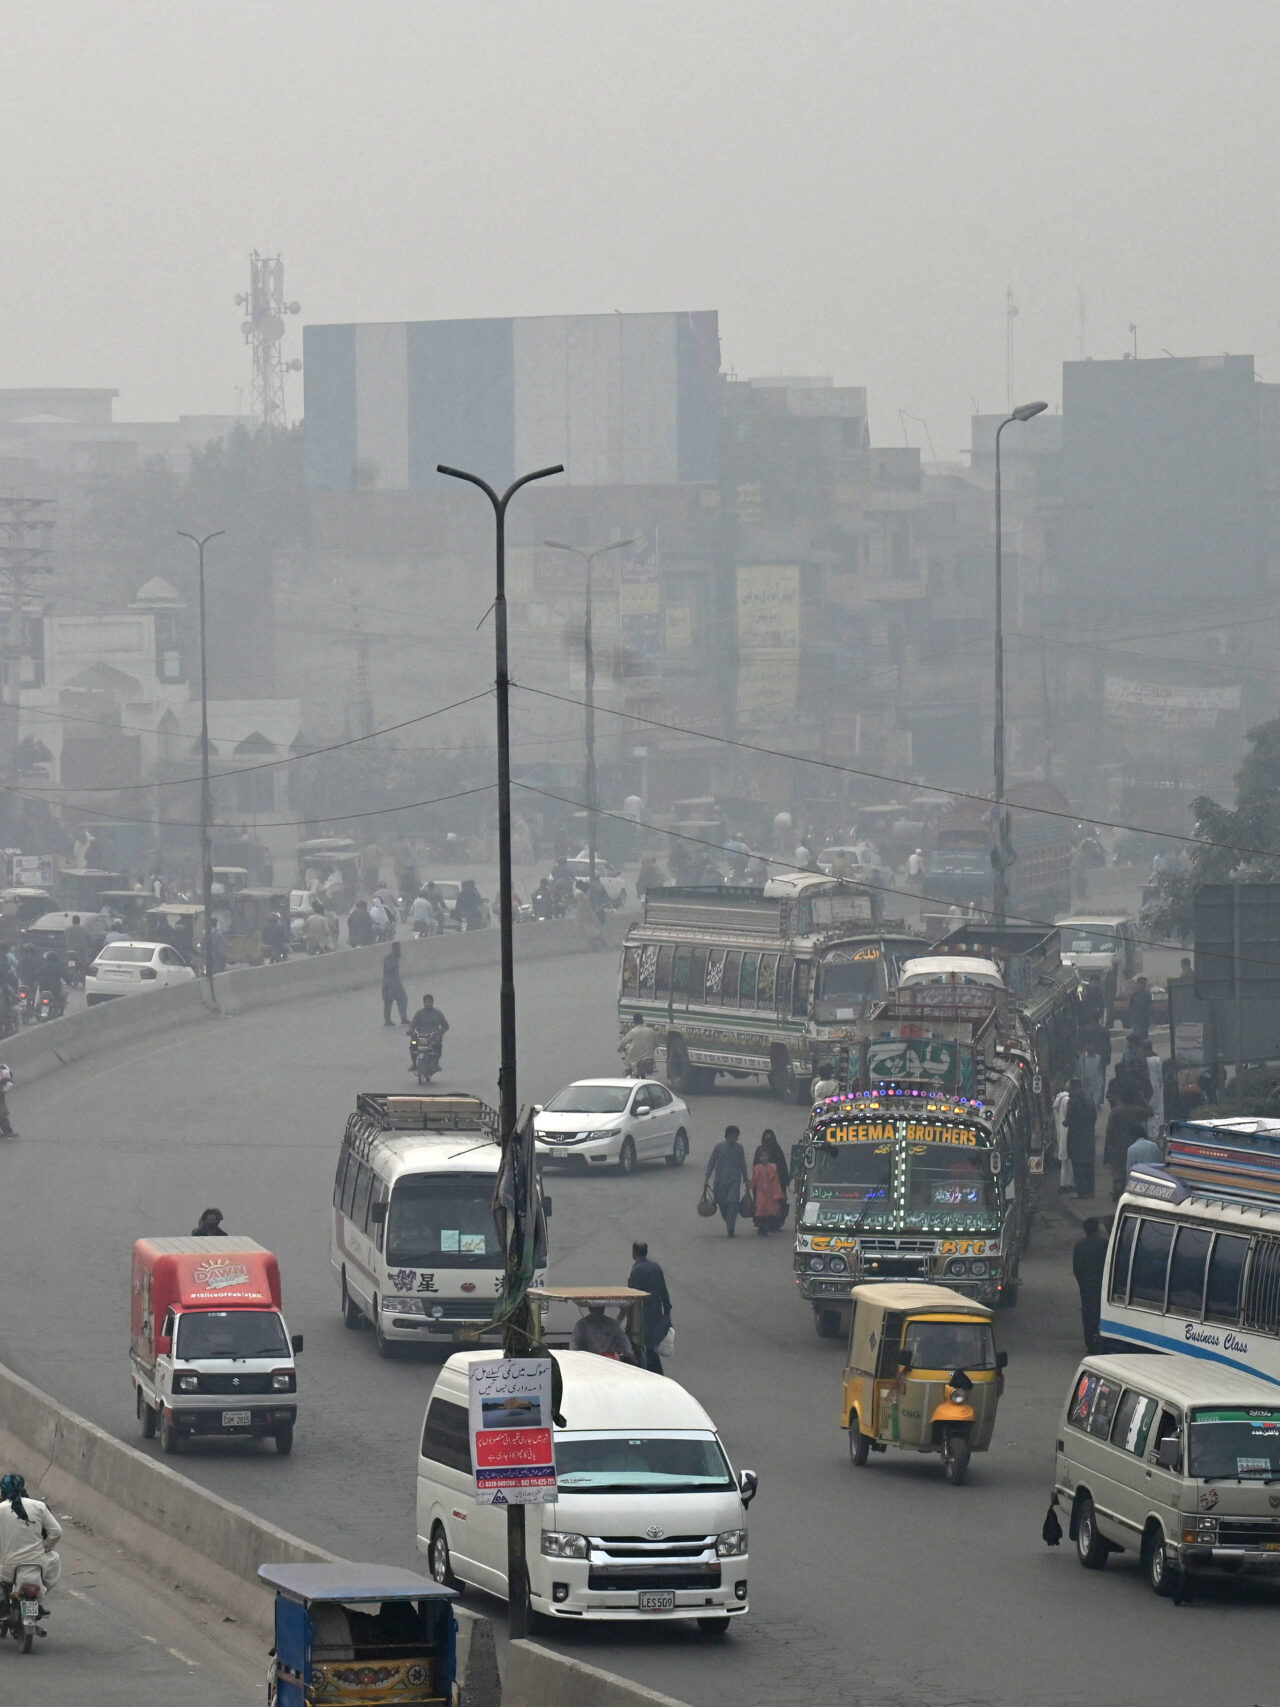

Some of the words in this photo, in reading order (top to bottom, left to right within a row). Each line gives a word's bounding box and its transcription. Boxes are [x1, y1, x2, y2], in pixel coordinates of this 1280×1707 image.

[826, 1124, 895, 1143] CHEEMA
[907, 1124, 977, 1146] BROTHERS
[938, 1239, 987, 1255] BTC
[194, 1264, 248, 1283] DAWN
[1184, 1323, 1220, 1346] Business
[1223, 1333, 1248, 1354] Class
[512, 1367, 526, 1379] میں
[902, 1408, 921, 1419] CNG
